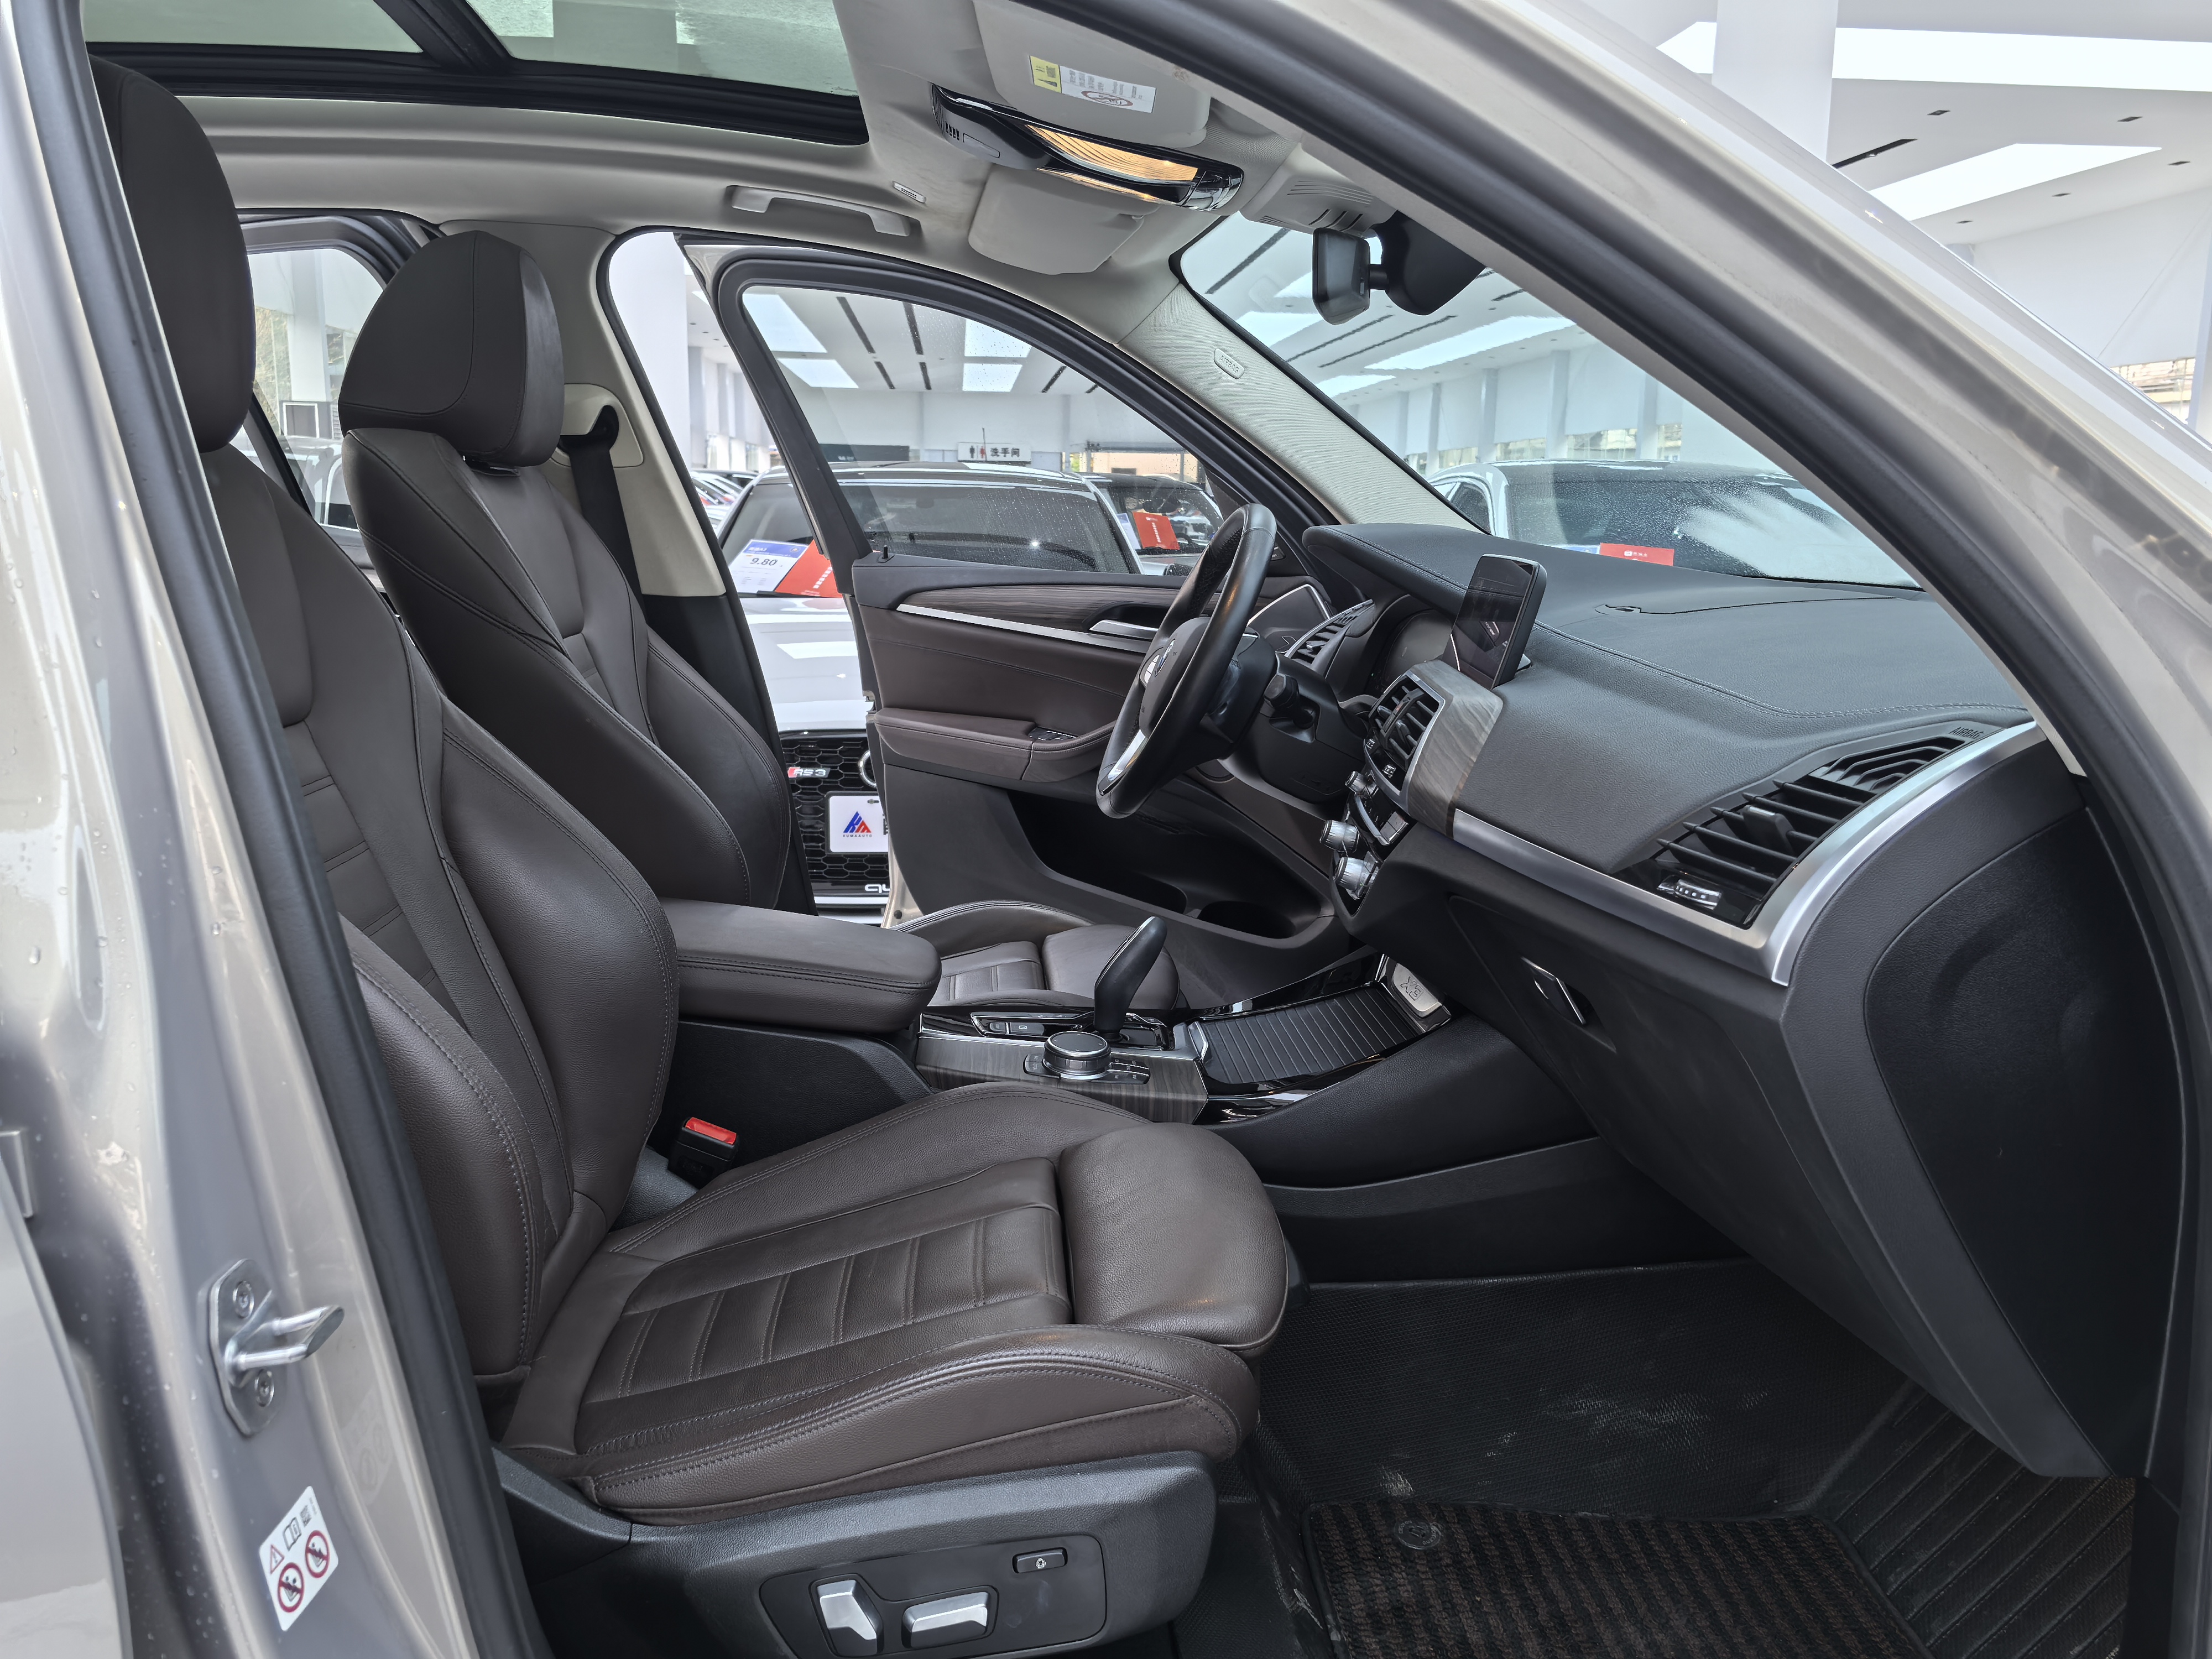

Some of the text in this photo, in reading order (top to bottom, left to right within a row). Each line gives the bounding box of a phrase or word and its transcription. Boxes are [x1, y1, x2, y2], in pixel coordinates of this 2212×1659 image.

[1218, 355, 1239, 373] AIRBAG
[990, 447, 1020, 457] 洗手间
[750, 557, 778, 566] 9.80
[1948, 727, 1984, 739] AIRBAG
[1400, 976, 1425, 1000] X3
